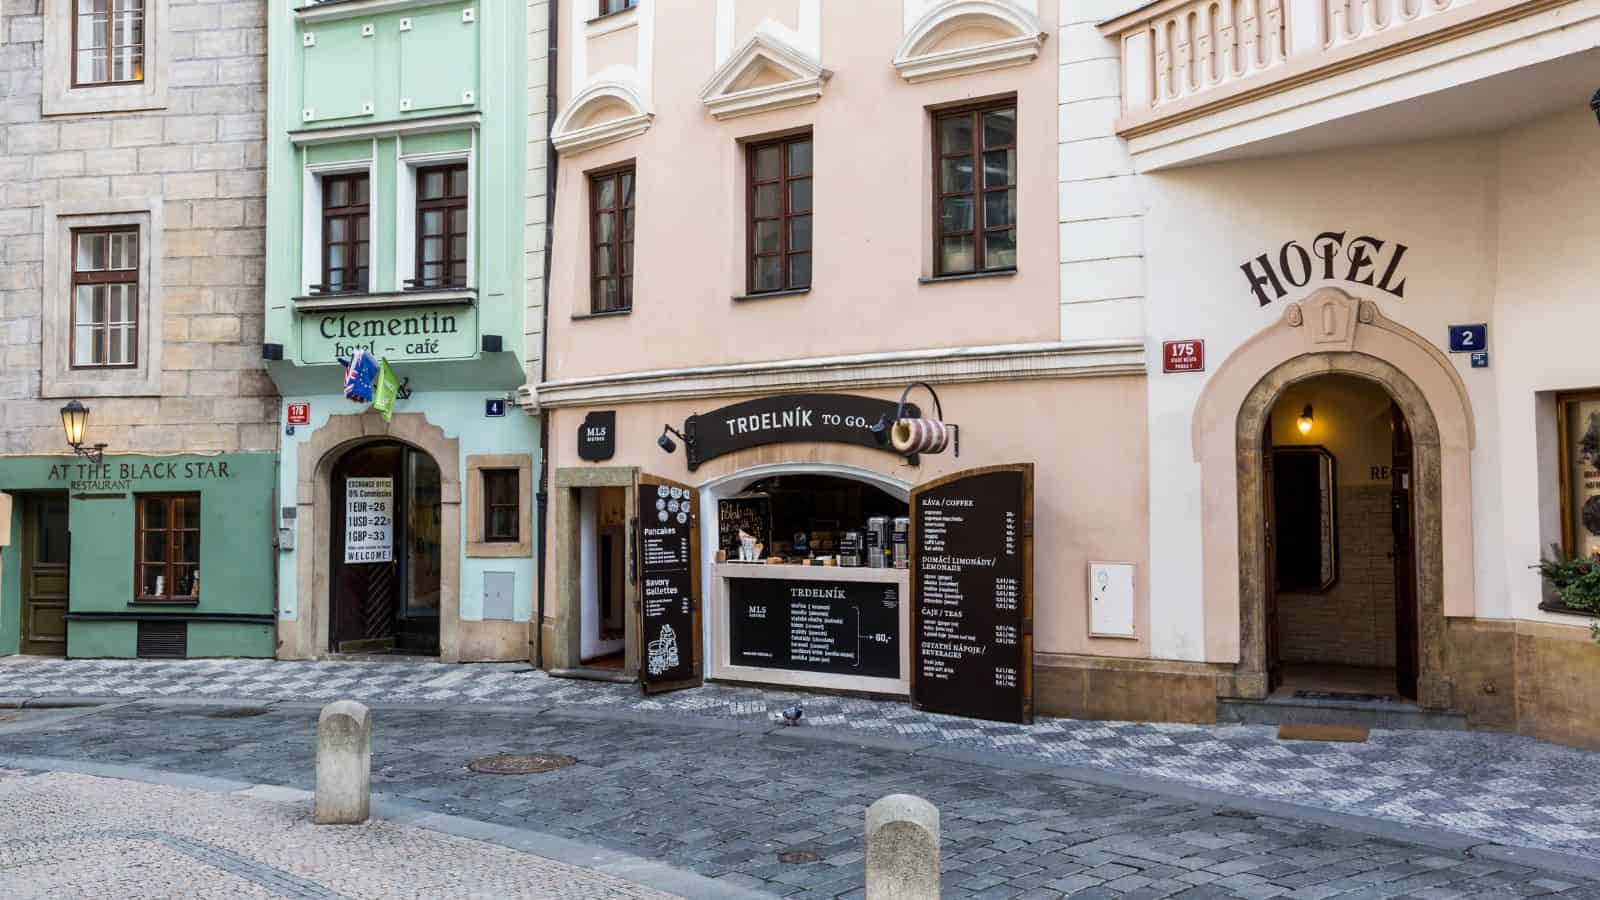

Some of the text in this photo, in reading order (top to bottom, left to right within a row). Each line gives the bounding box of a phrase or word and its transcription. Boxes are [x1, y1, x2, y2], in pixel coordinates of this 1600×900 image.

[1240, 231, 1408, 308] HOTEL
[319, 310, 457, 339] Clementin
[1462, 330, 1473, 345] 2
[335, 340, 375, 358] hotel
[405, 339, 440, 355] café
[1172, 343, 1194, 356] 175
[491, 404, 497, 413] 4
[726, 407, 813, 436] TRDELNÍK
[822, 414, 841, 427] TO
[48, 461, 230, 481] AT THE BLACK STAR
[71, 480, 132, 490] RESTAURANT
[946, 499, 974, 507] COFFEE
[790, 587, 847, 599] TRDELNÍK
